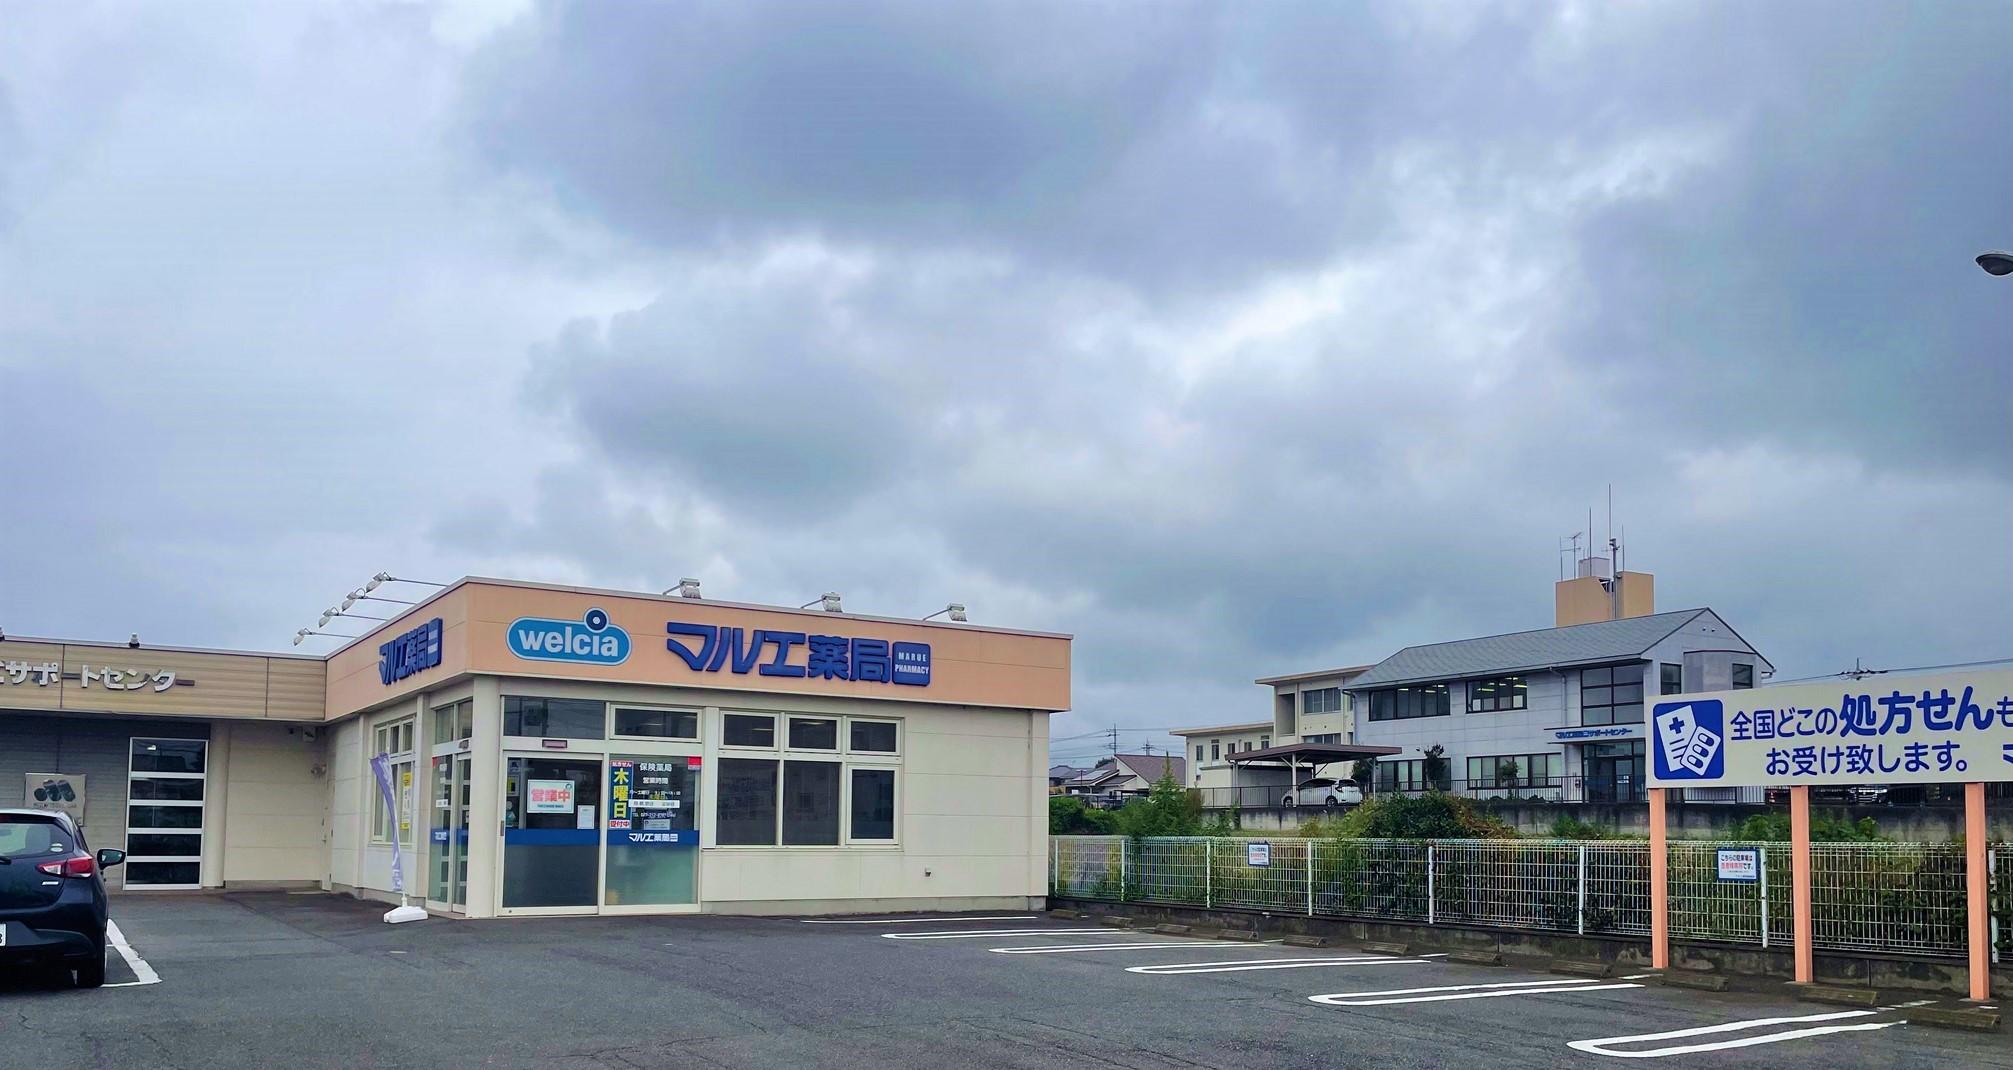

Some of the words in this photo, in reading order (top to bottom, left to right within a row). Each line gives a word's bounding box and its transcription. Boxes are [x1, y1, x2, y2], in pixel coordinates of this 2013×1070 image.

[518, 626, 619, 657] welcia
[667, 621, 891, 683] マルエ薬局
[898, 652, 927, 662] MARUE
[0, 661, 196, 693] サポートセンター
[895, 664, 929, 674] PHARMACY
[1766, 740, 1968, 776] お受け致します。
